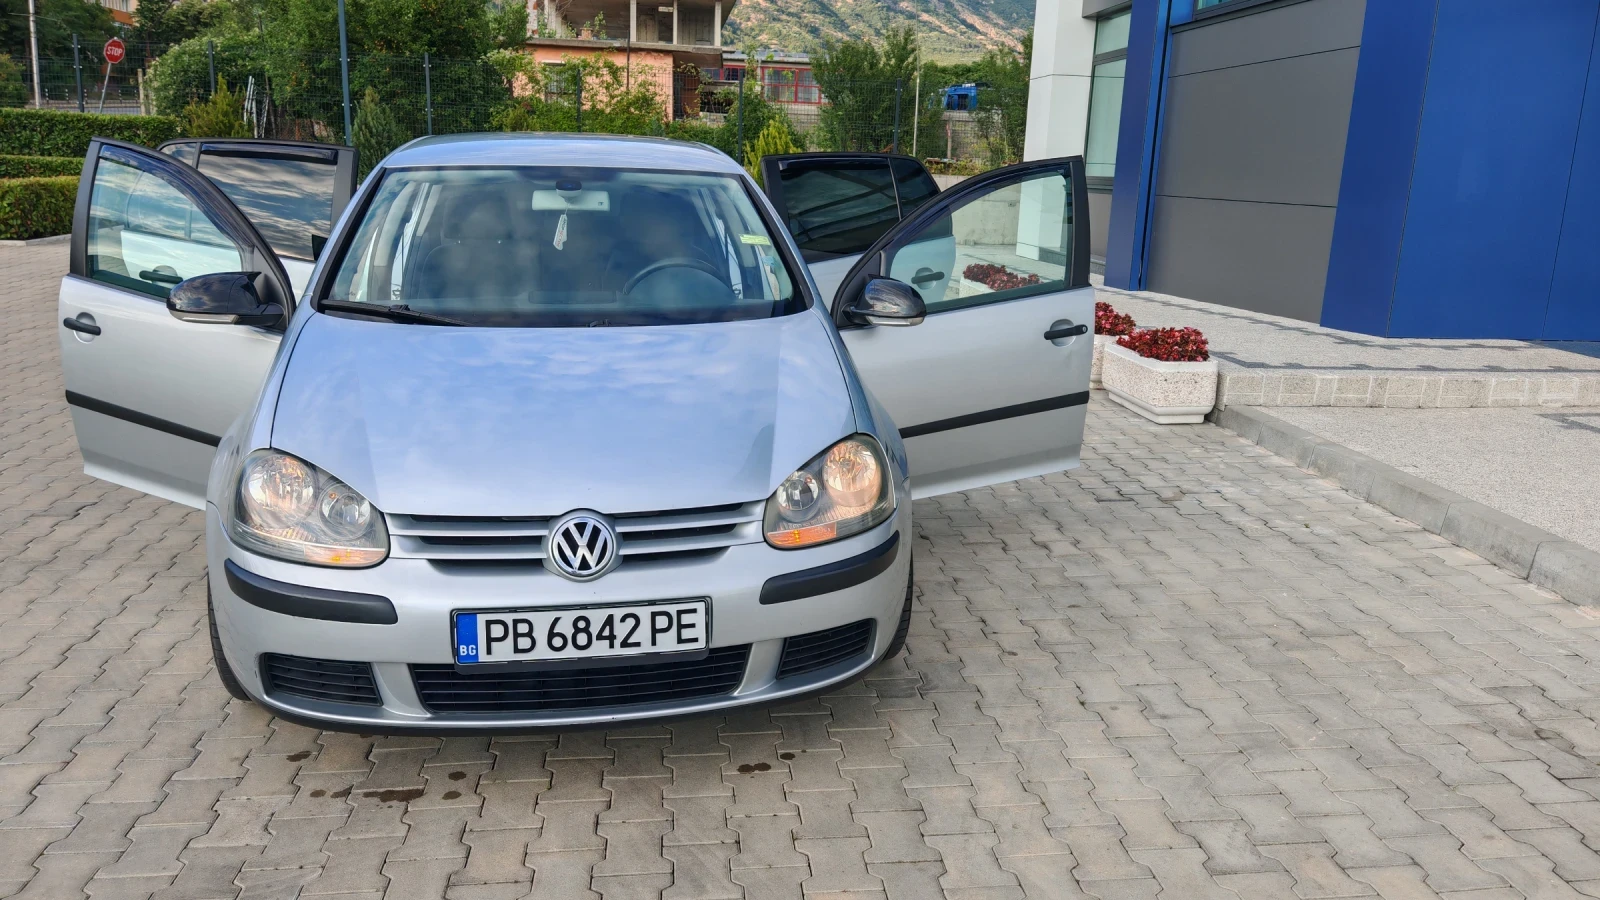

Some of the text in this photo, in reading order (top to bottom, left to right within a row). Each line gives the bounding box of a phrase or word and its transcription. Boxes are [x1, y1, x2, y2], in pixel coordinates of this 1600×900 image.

[106, 46, 123, 57] STOP
[485, 608, 699, 655] PB 6842 PE
[459, 645, 477, 657] BG
